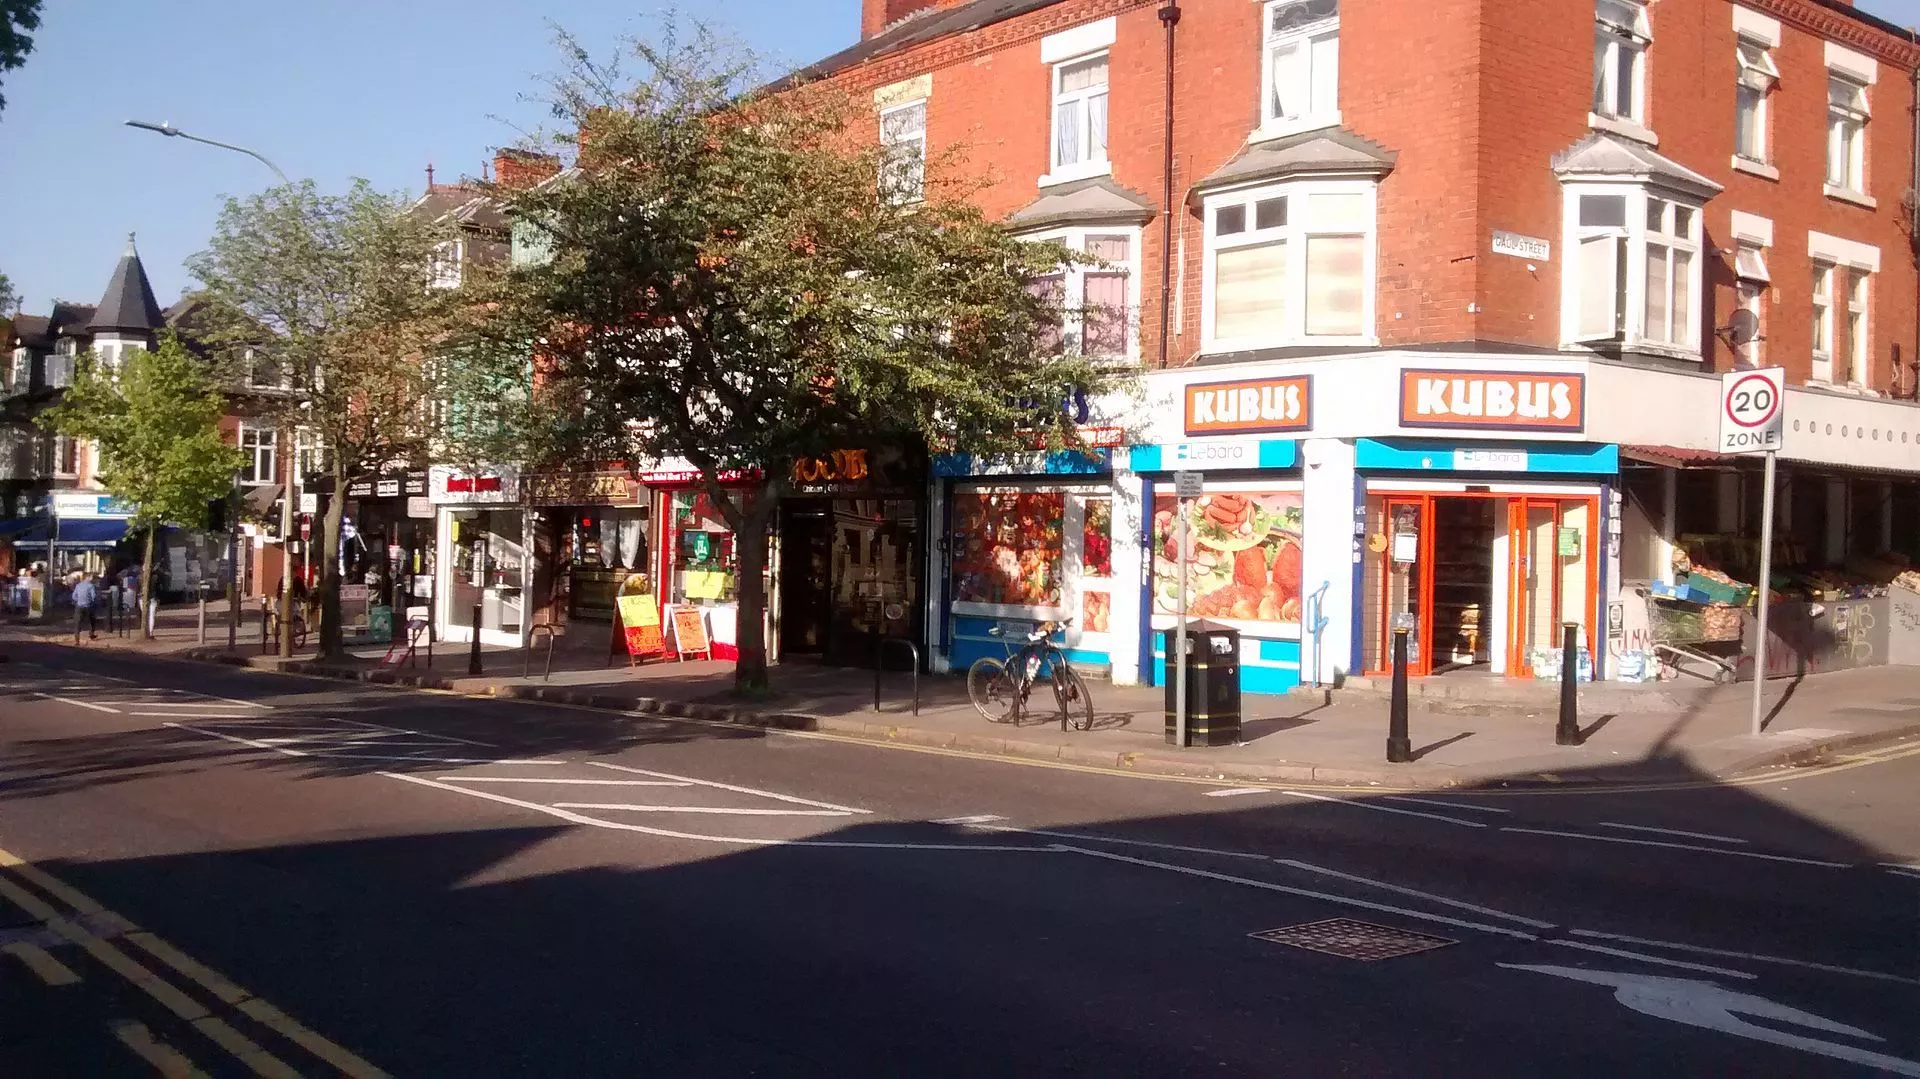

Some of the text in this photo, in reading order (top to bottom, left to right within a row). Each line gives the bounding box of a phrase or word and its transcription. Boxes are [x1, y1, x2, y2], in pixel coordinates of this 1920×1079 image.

[1520, 240, 1547, 256] STREET
[1193, 384, 1301, 424] KUBUS
[1417, 378, 1572, 420] KUBUS
[1735, 389, 1771, 412] 20
[1726, 430, 1774, 447] ZONE
[1190, 442, 1243, 460] Lebara
